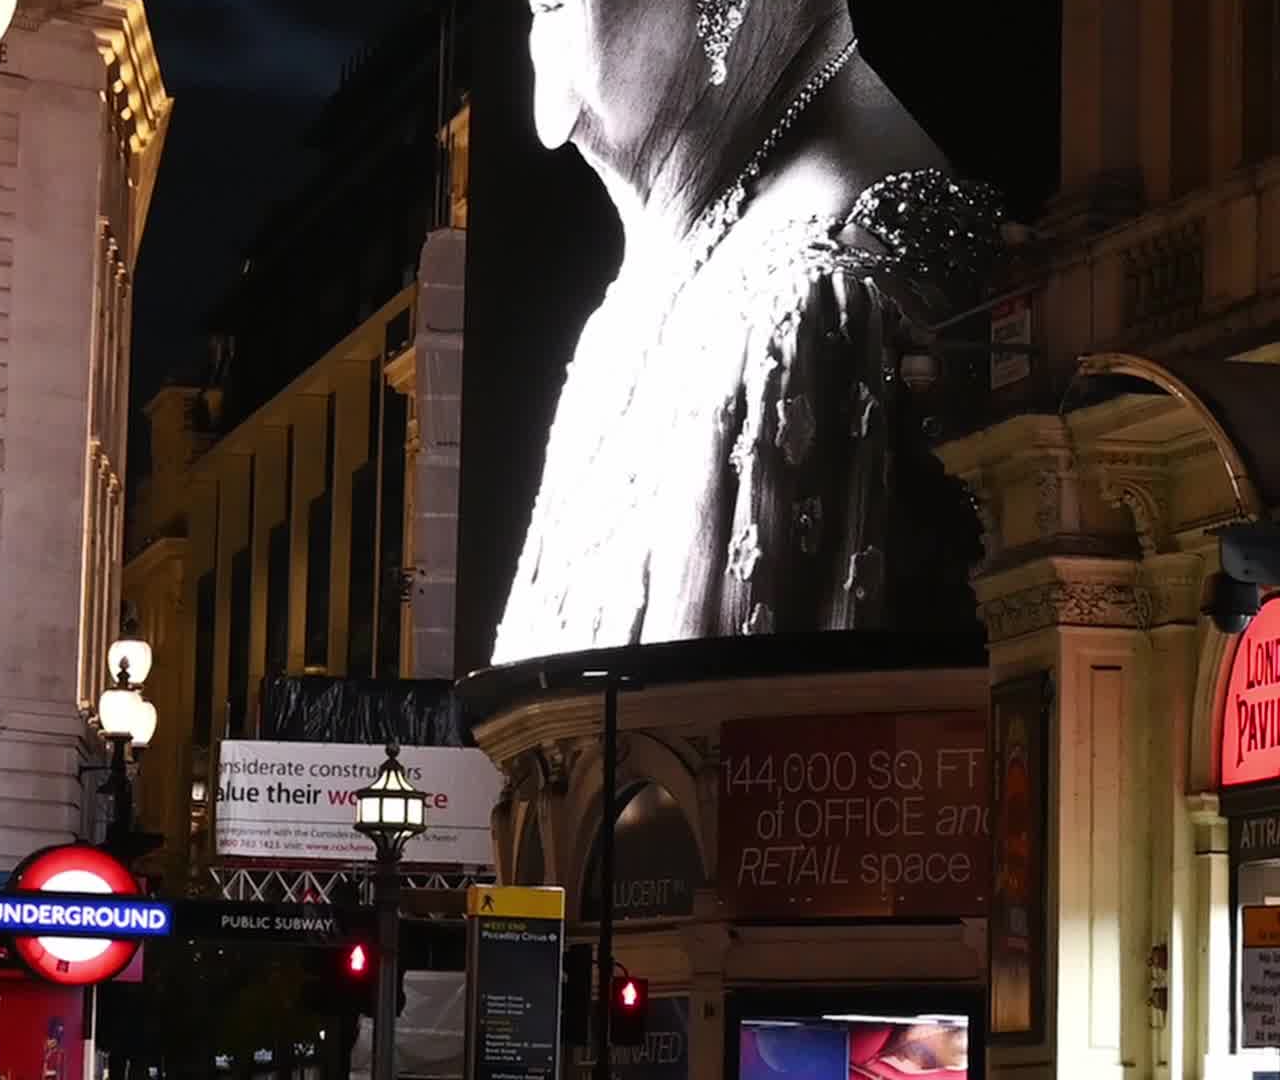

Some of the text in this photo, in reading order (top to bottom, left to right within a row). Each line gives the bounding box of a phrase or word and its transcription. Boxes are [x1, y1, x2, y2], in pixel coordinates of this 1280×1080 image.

[219, 759, 422, 780] nsiderate construrs
[720, 747, 984, 799] 144,000 SQ FT
[216, 780, 260, 803] alue
[266, 782, 322, 805] their
[757, 797, 785, 841] of
[794, 795, 925, 839] OFFICE
[737, 844, 971, 896] RETAIL space
[221, 915, 334, 932] PUBLIC SUBWAY
